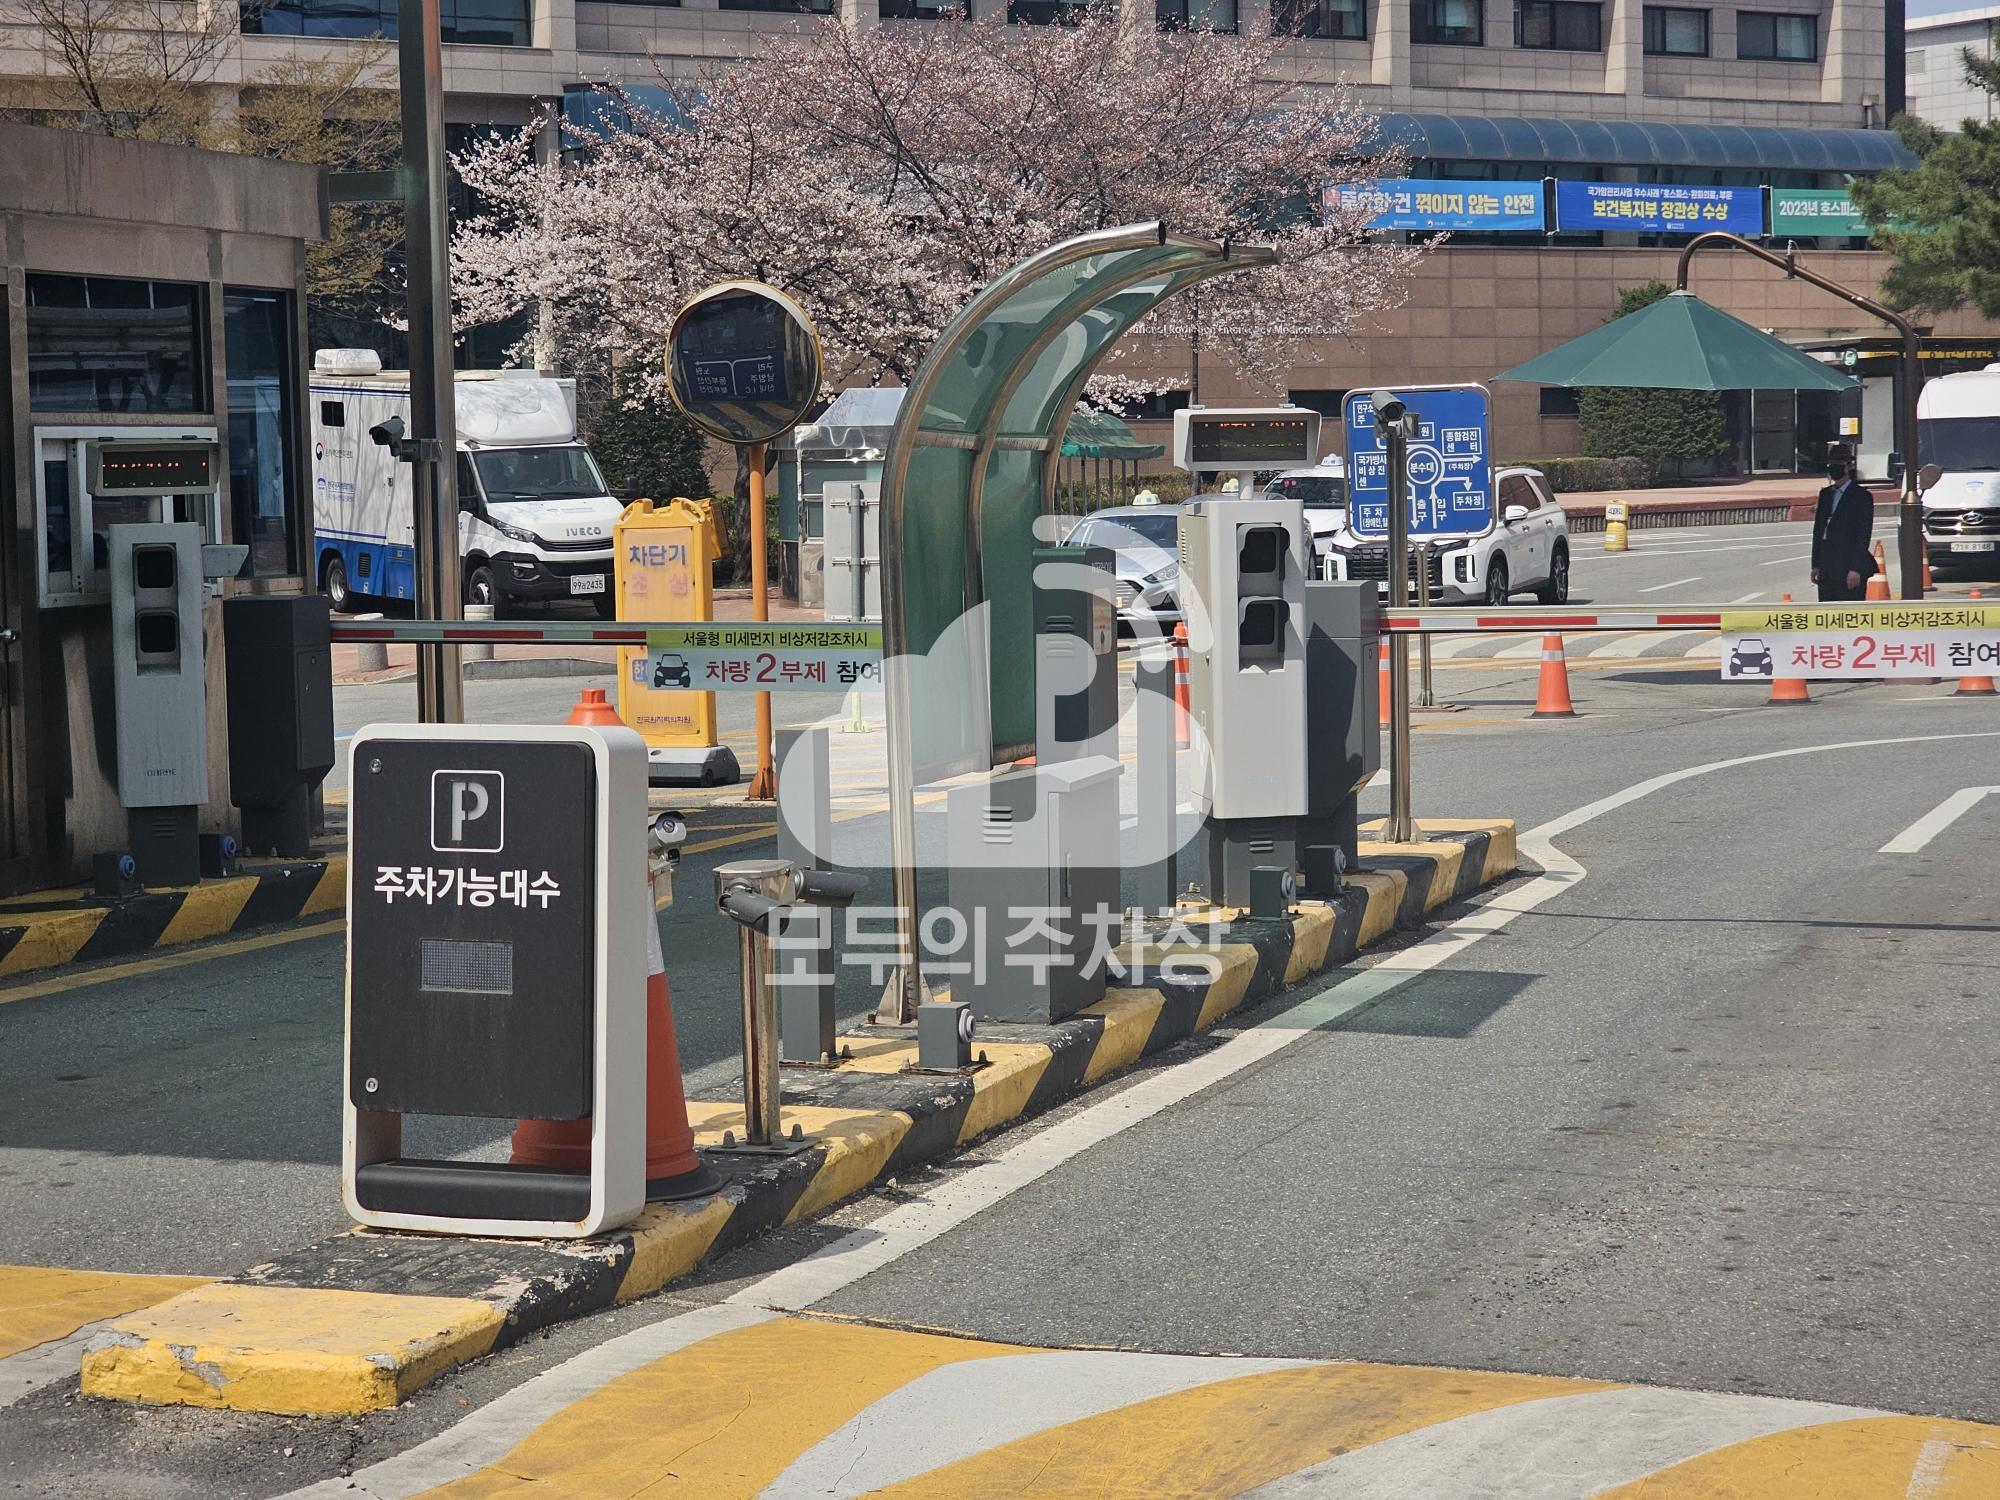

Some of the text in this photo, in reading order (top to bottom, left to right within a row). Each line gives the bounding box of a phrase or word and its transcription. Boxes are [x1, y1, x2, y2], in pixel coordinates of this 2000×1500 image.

[1395, 192, 1411, 214] 건
[1416, 193, 1464, 215] 꺾이지
[1468, 194, 1499, 215] 않는
[1503, 194, 1535, 215] 안전
[1593, 200, 1728, 221] 보건복지부 장관상 수상
[1779, 201, 1861, 217] 2023년 호스피스
[1445, 431, 1478, 442] 종합검진
[1358, 454, 1387, 465] 국가방사
[1410, 461, 1435, 474] 분수대
[1456, 495, 1482, 506] 주차장
[565, 526, 602, 537] IVECO
[629, 544, 687, 567] 차단기
[1765, 610, 1985, 630] 서울형 미세먼지 비상저감조치시
[683, 631, 869, 647] 서울형 미세먼지 비상저감조치시
[1947, 641, 2000, 667] 참여
[836, 660, 882, 683] 참여
[451, 781, 490, 841] P
[374, 865, 561, 909] 주차가능대수
